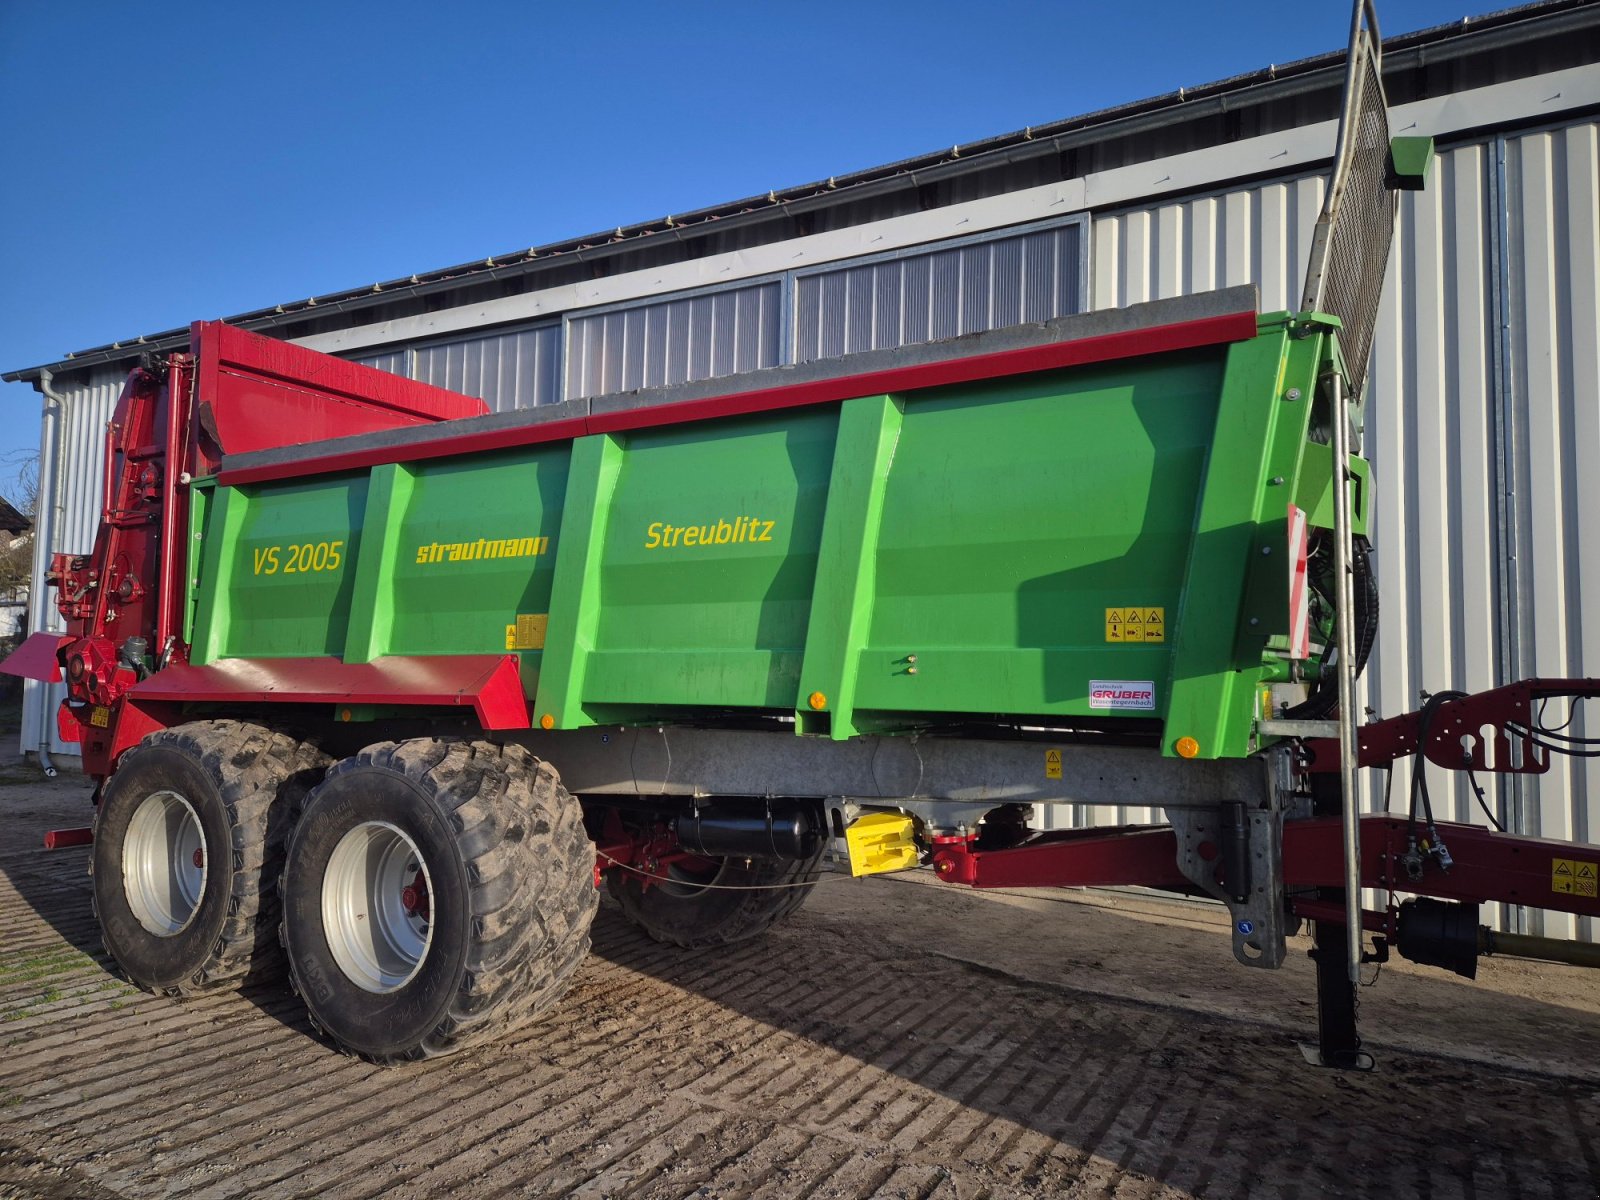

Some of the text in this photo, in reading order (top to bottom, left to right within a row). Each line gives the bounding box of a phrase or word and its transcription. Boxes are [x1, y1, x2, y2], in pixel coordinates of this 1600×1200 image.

[645, 516, 776, 549] Streublitz
[254, 541, 344, 576] VS 2005
[416, 536, 549, 564] strautmann
[1092, 690, 1152, 700] GRUBER
[302, 958, 330, 1002] BKT
